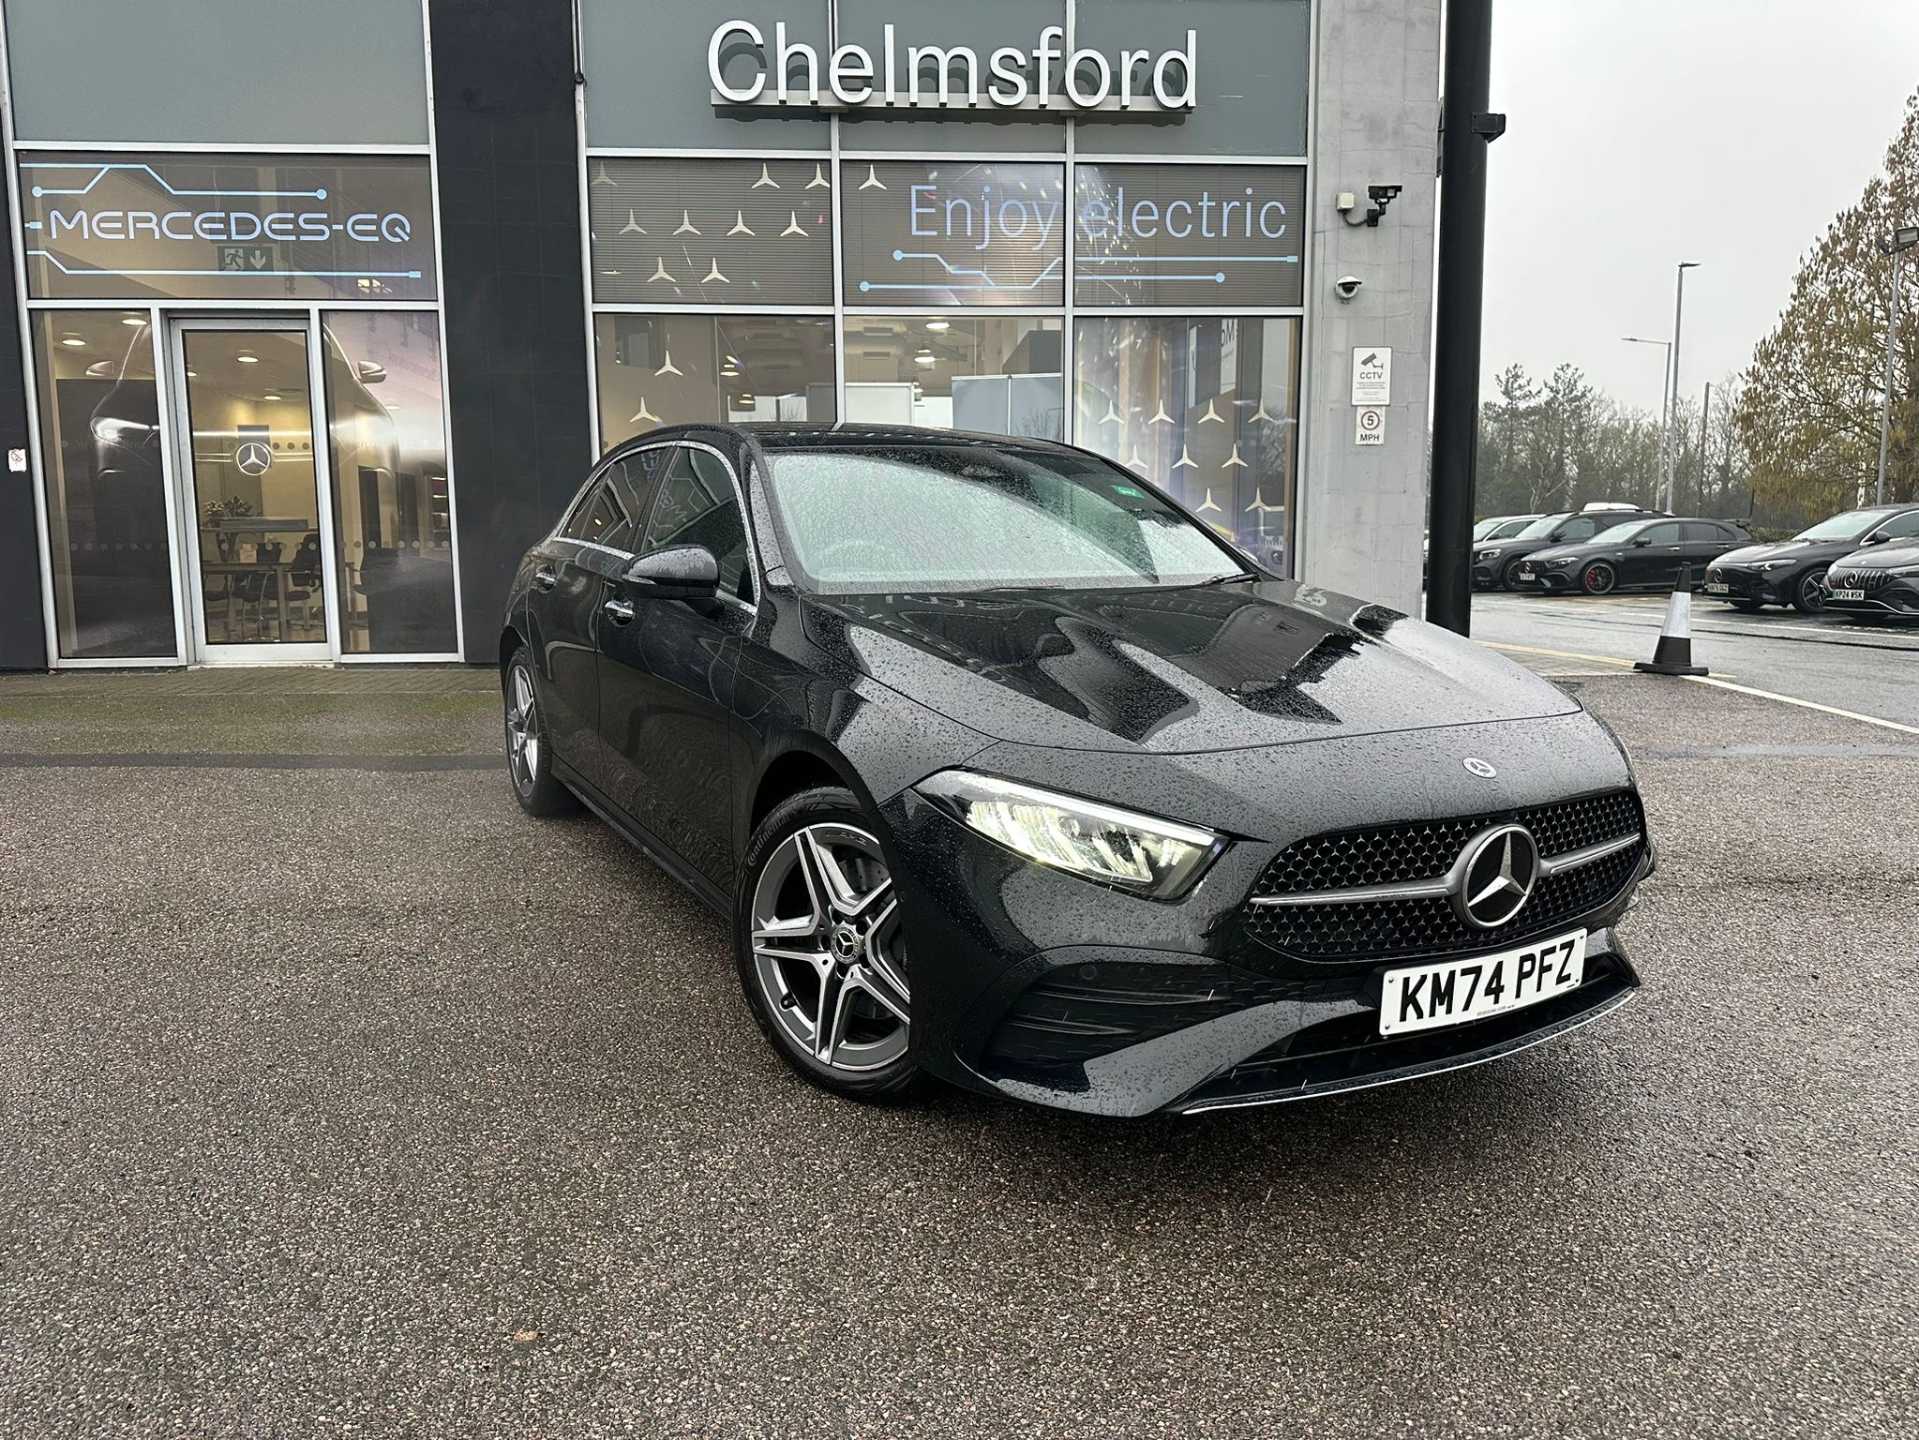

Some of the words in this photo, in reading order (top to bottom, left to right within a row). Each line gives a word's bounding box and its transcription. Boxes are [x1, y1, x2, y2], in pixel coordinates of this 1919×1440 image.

[706, 19, 1197, 110] Chelmsford
[49, 208, 412, 243] MERCEDES-EQ
[909, 184, 1060, 250] Enjoy
[1081, 187, 1288, 239] electric
[1359, 371, 1383, 380] CCTV
[1359, 433, 1380, 442] MPH
[1366, 415, 1375, 427] 5
[1398, 960, 1505, 1023] KM74
[1514, 938, 1576, 1000] PFZ
